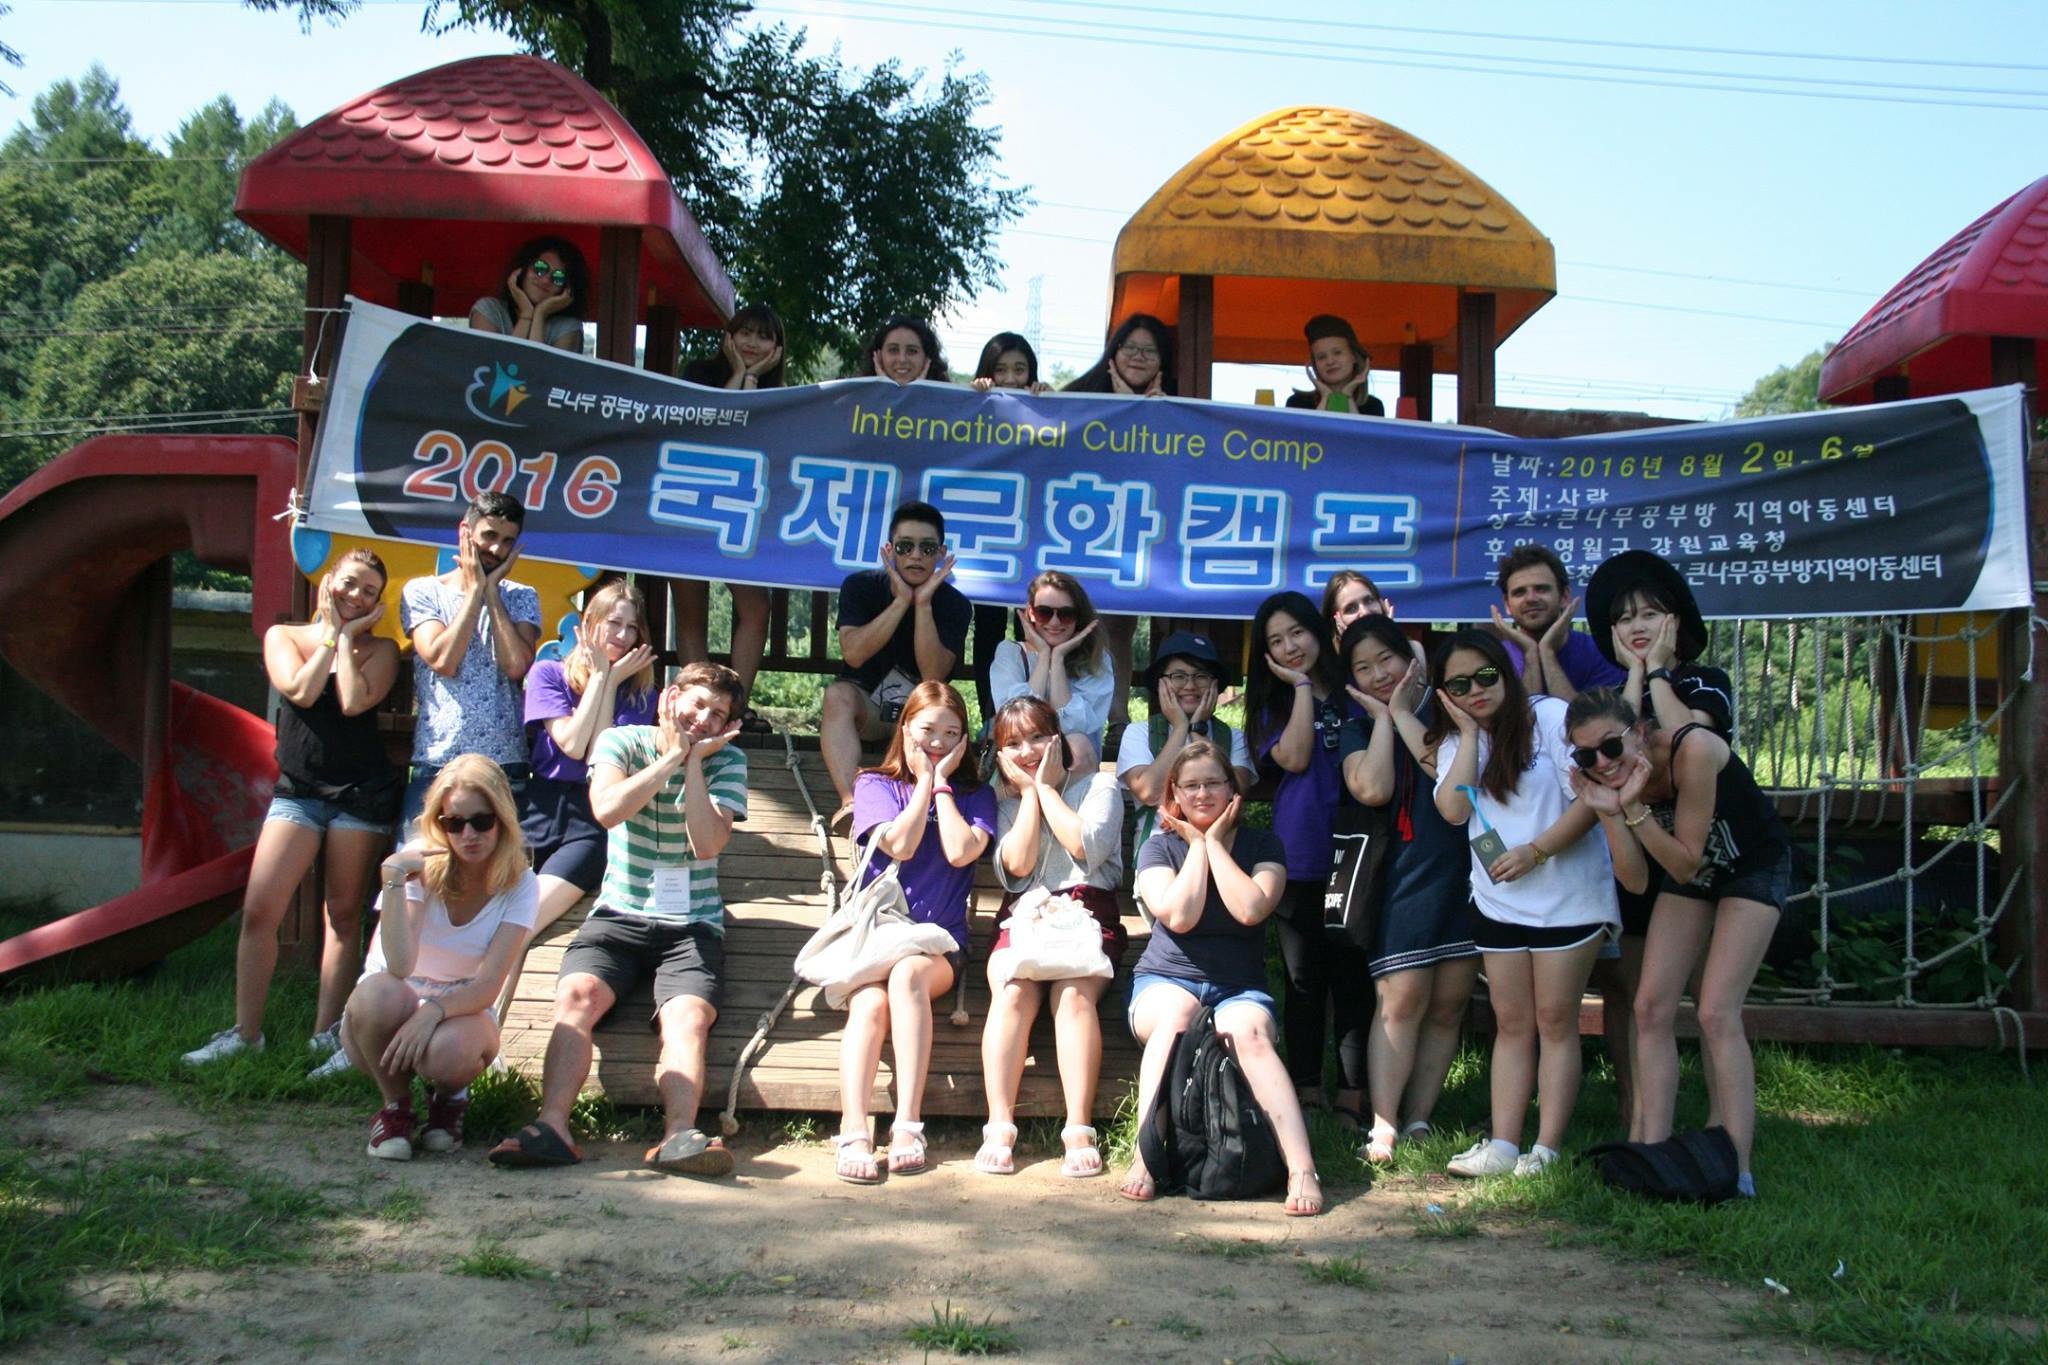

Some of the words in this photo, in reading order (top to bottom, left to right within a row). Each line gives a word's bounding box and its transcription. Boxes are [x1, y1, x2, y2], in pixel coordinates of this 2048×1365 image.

[547, 387, 597, 414] 큰나무
[600, 395, 650, 424] 공부방
[651, 404, 749, 427] 지역아동센터
[851, 404, 1067, 448] International
[1082, 421, 1206, 458] Culture
[1222, 429, 1324, 470] Camp
[403, 430, 621, 519] 2016
[1733, 495, 1897, 525] 지역아동센터
